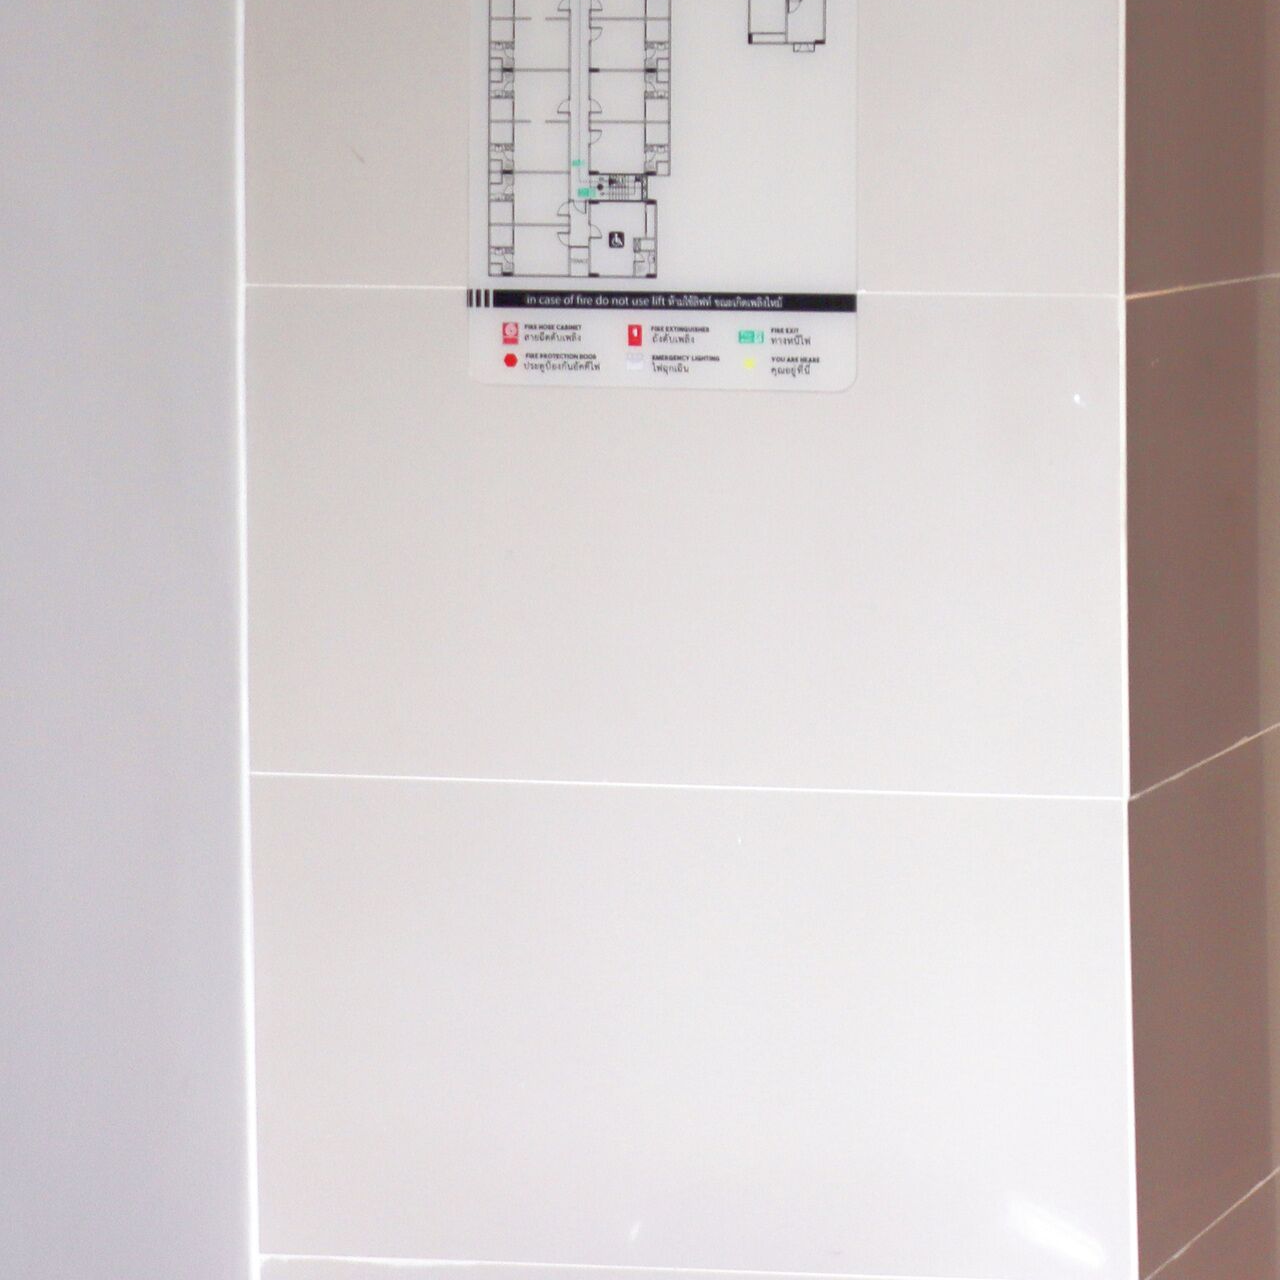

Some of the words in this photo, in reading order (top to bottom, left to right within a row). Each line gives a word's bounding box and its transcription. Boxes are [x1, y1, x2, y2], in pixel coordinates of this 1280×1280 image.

[526, 295, 537, 305] in
[539, 297, 561, 305] case
[564, 295, 575, 305] of
[576, 295, 593, 305] fire
[595, 296, 609, 306] do
[611, 297, 629, 306] not
[632, 298, 649, 307] use
[652, 296, 665, 307] lift
